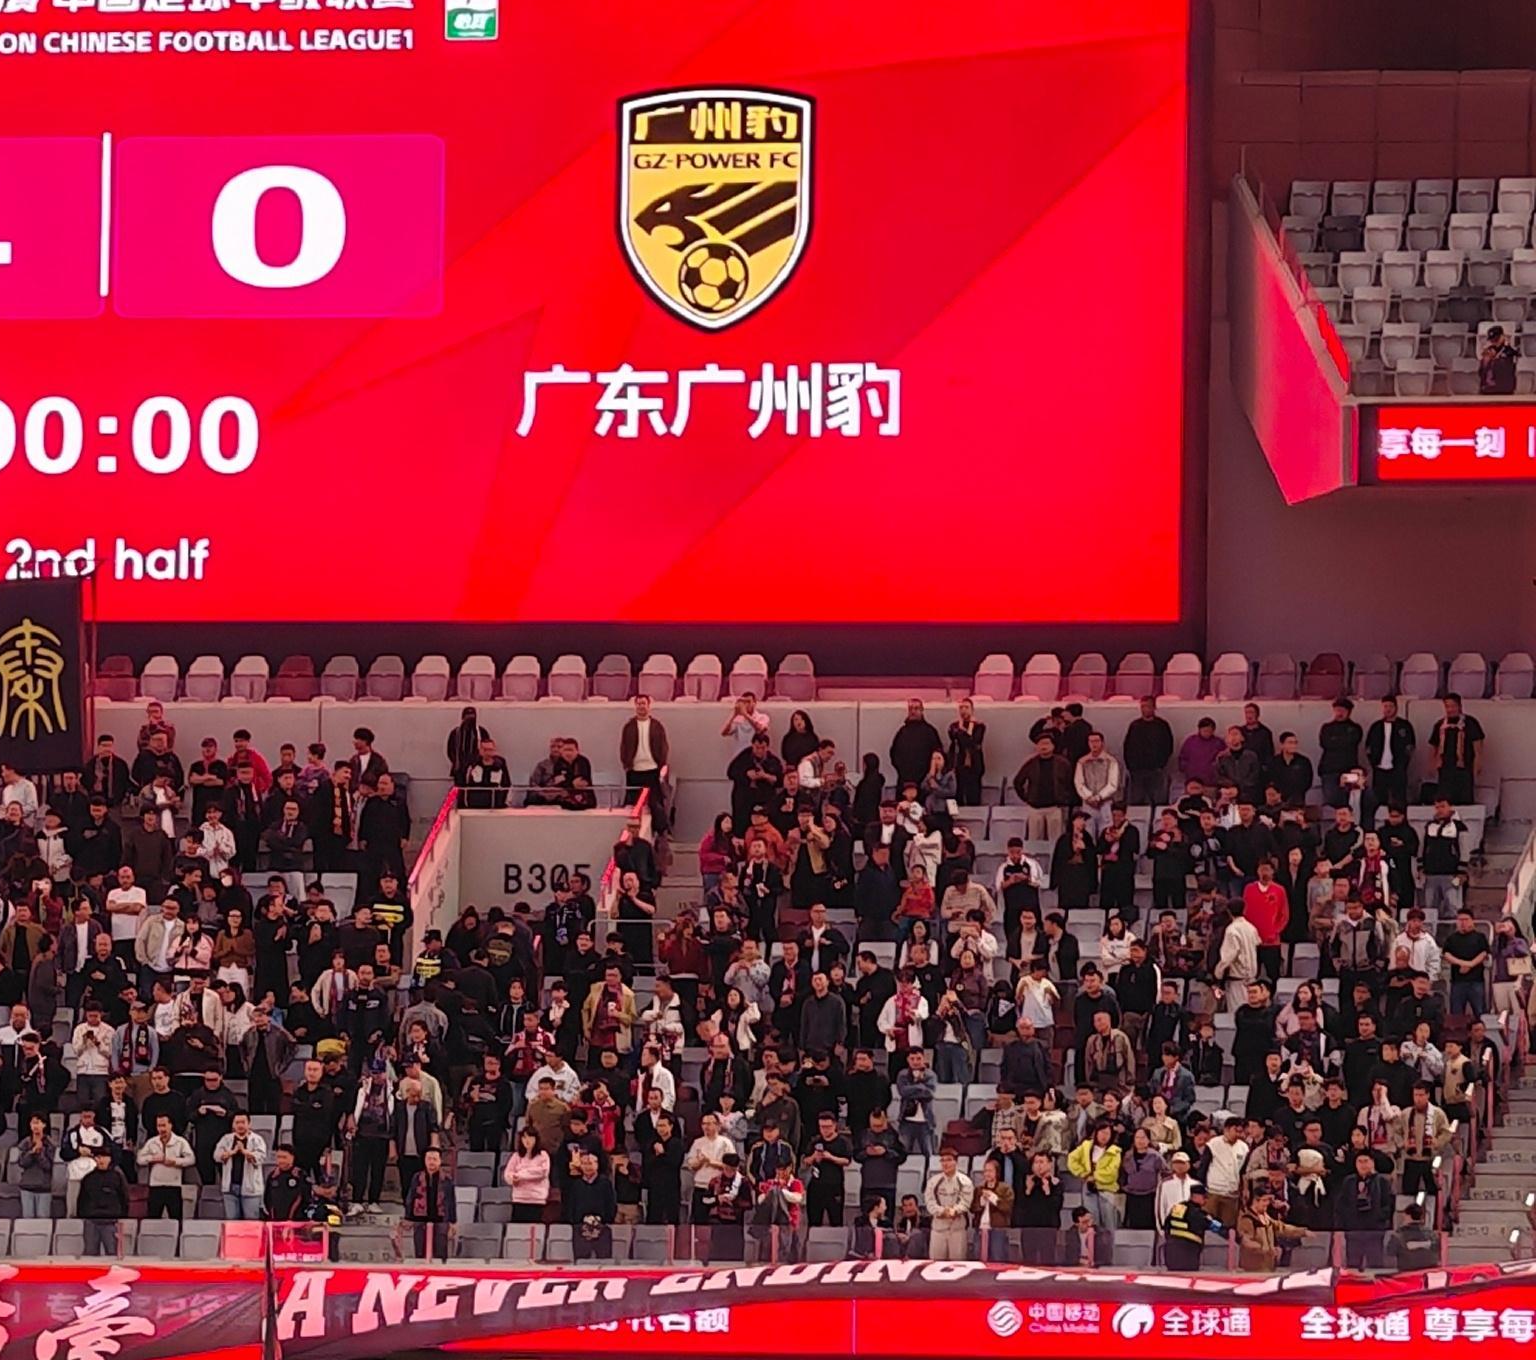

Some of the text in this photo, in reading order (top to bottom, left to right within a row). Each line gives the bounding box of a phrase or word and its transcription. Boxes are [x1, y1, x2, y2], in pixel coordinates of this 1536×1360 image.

[43, 30, 153, 54] CHINESE
[158, 29, 294, 53] FOOTBALL
[633, 100, 799, 141] 广州豹
[633, 151, 799, 170] GZ-POWER FC
[211, 165, 348, 289] 0
[516, 362, 902, 439] 广东广州豹
[4, 537, 210, 581] 2nd half
[277, 1270, 335, 1341] A
[1161, 1307, 1252, 1337] 全球通
[1299, 1306, 1411, 1341] 全球通
